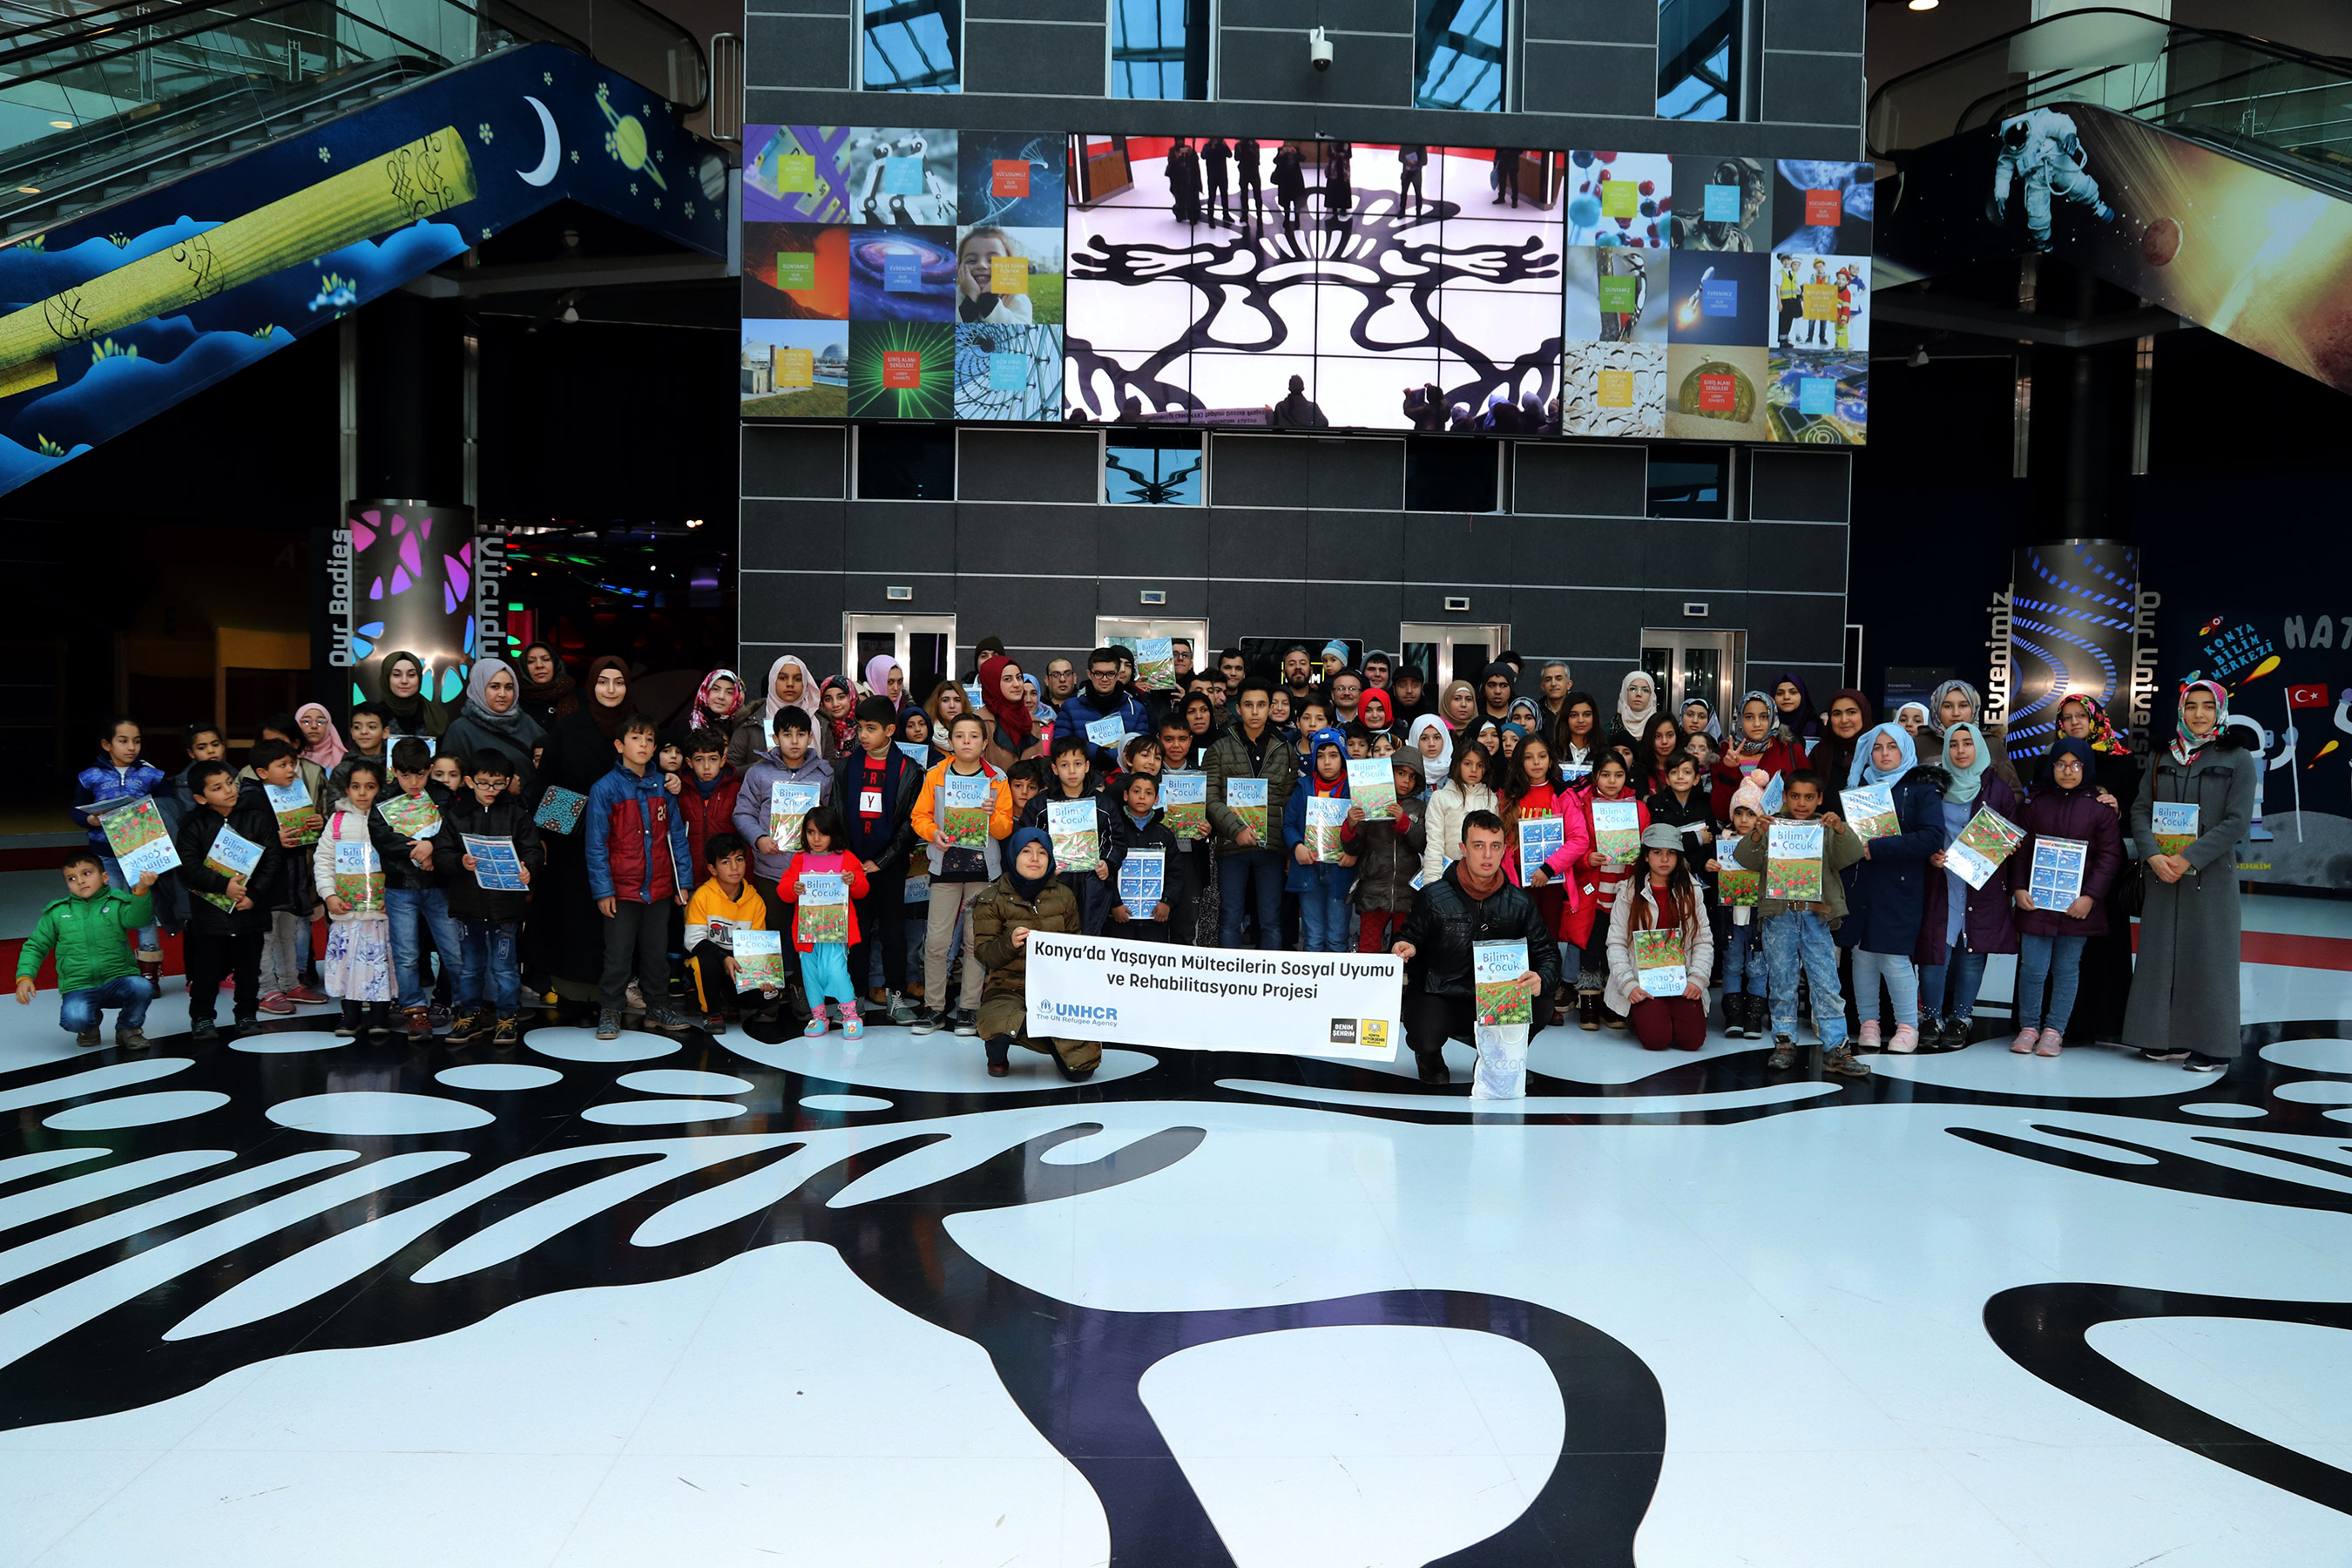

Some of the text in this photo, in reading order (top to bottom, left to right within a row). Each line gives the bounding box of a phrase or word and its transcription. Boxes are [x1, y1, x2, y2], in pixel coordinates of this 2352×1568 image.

[328, 530, 350, 666] Our Bodies
[476, 537, 507, 659] Vücudu
[2138, 591, 2161, 639] Our
[2203, 623, 2255, 656] KONYA
[2213, 633, 2260, 666] BİLİM
[1984, 591, 2011, 726] Evrenimiz
[2211, 639, 2274, 681] MERKEZİ
[1092, 723, 1112, 733] Bilim
[952, 781, 973, 790] Bilim
[274, 787, 293, 796] Bilim
[780, 788, 802, 797] Bilim
[956, 791, 982, 800] Çocuk
[280, 794, 303, 803] Çocuk
[784, 798, 811, 807] Çocuk
[868, 795, 875, 808] Y
[1056, 808, 1078, 816] Bilim
[2159, 808, 2180, 817] Bilim
[1061, 816, 1089, 825] Çocuk
[1778, 831, 1803, 840] Bilim
[222, 836, 244, 854] Bilim
[1783, 841, 1813, 850] Çocuk
[131, 848, 161, 868] Çocuk
[223, 848, 247, 866] Çocuk
[144, 856, 171, 871] Bilim
[812, 889, 840, 898] Çocuk
[1483, 951, 1509, 962] Bilim
[1111, 947, 1177, 969] Yaşayan
[1181, 955, 1276, 975] Mültecilerin
[1281, 961, 1335, 979] Sosyal
[1340, 963, 1395, 980] Uyumu
[1490, 963, 1520, 973] Çocuk
[1647, 974, 1674, 983] Çocuk
[1106, 973, 1318, 1001] ve Rehabilitasyonu Projesi
[1659, 983, 1680, 991] Bilim
[1056, 1003, 1118, 1020] UNHCR
[1062, 1016, 1091, 1024] Refugee
[1092, 1019, 1118, 1028] Agency
[1484, 1059, 1525, 1071] eczan
